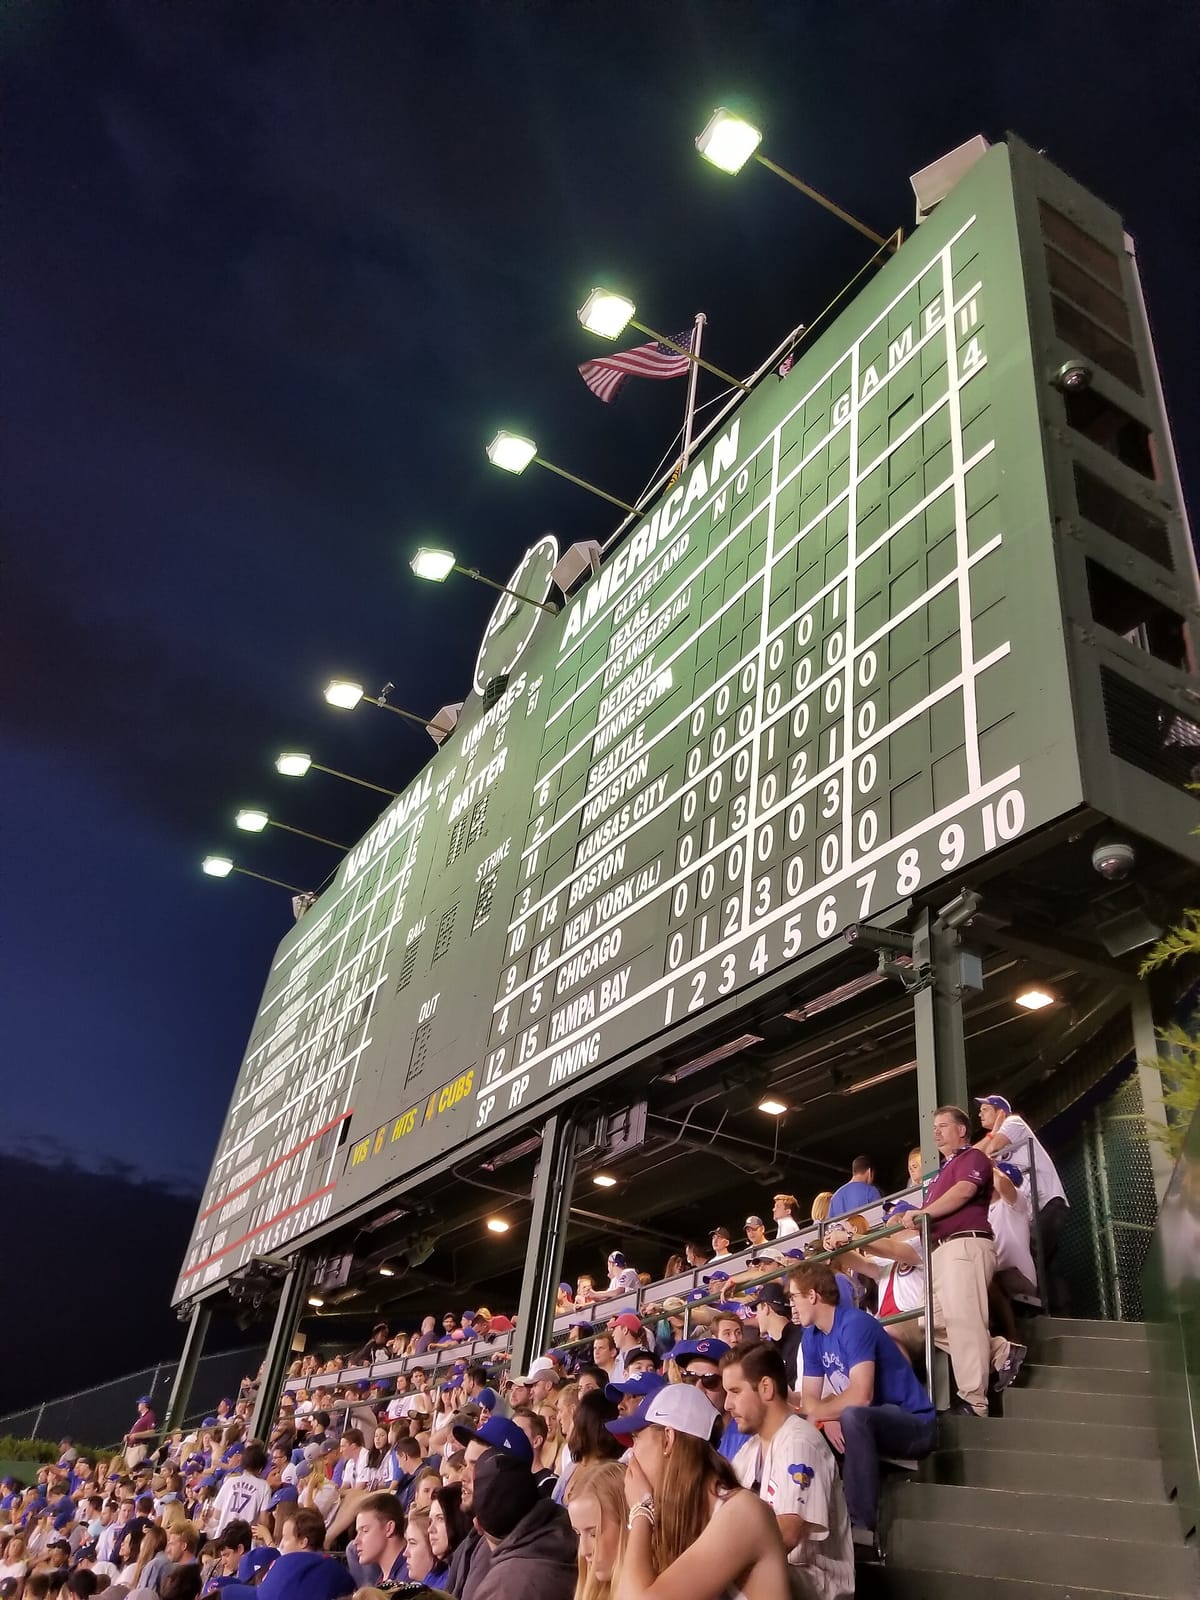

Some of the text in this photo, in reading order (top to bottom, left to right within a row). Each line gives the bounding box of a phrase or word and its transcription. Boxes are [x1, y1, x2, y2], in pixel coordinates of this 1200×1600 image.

[559, 417, 741, 654] AMERICAN
[598, 342, 984, 722] DETROIT 4
[604, 656, 623, 689] LOS
[624, 608, 671, 669] ANGELES
[961, 299, 977, 334] 11
[610, 601, 650, 653] TEXAS
[613, 532, 690, 625] CLEVELAND
[461, 671, 527, 757] UMPIRES
[520, 632, 842, 914] 3 KANSAS CITY 0 0 0 0 0 0
[526, 588, 839, 879] 11 HOUSTON 0 0 0 0 0 1
[539, 668, 672, 806] 6 MINNESOTA
[341, 766, 434, 889] NATIONAL
[448, 747, 508, 825] BATTER
[510, 651, 876, 957] 10 14 BOSTON 0 0 0 1 0 0 0
[532, 724, 645, 842] 2 SEATTLE
[475, 837, 512, 882] STRIKE
[498, 754, 876, 1034] 4 5 CHICAGO 0 0 0 0 0 3 0
[506, 701, 876, 994] 9 14 NEW YORK (AL) 0 1 3 0 2 1 0
[406, 916, 426, 946] BALL
[476, 790, 1025, 1127] SP RP INNING 1 2 3 4 5 6 7 8 9 10
[486, 810, 877, 1084] 12 15 TAMPA BAY 0 1 2 3 0 0 0
[419, 993, 440, 1023] OUT
[352, 1138, 370, 1167] VIS
[392, 1108, 418, 1142] HITS
[425, 1093, 437, 1120] 4
[438, 1070, 474, 1112] CUBS
[239, 1244, 246, 1267] 1
[256, 1234, 264, 1254] 3
[264, 1229, 272, 1251] 4
[272, 1223, 282, 1248] 5
[281, 1218, 290, 1242] 6
[291, 1212, 301, 1237] 7
[300, 1207, 310, 1232] 8
[310, 1201, 319, 1226] 9
[318, 1193, 332, 1222] 10
[696, 1342, 710, 1352] C
[230, 1492, 252, 1513] 17
